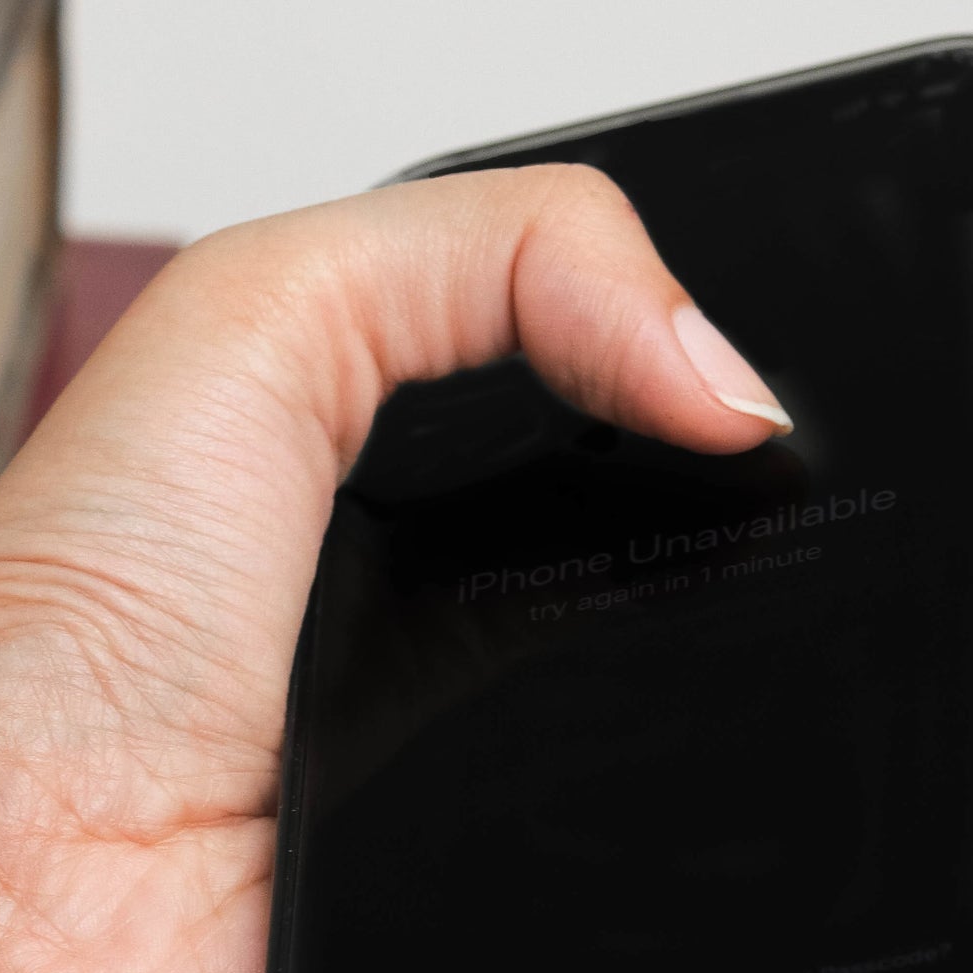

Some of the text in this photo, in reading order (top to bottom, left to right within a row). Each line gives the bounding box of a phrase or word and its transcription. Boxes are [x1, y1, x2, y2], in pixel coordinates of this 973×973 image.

[457, 488, 896, 604] iPhone Unavailable
[528, 543, 823, 622] try again in 1 minute
